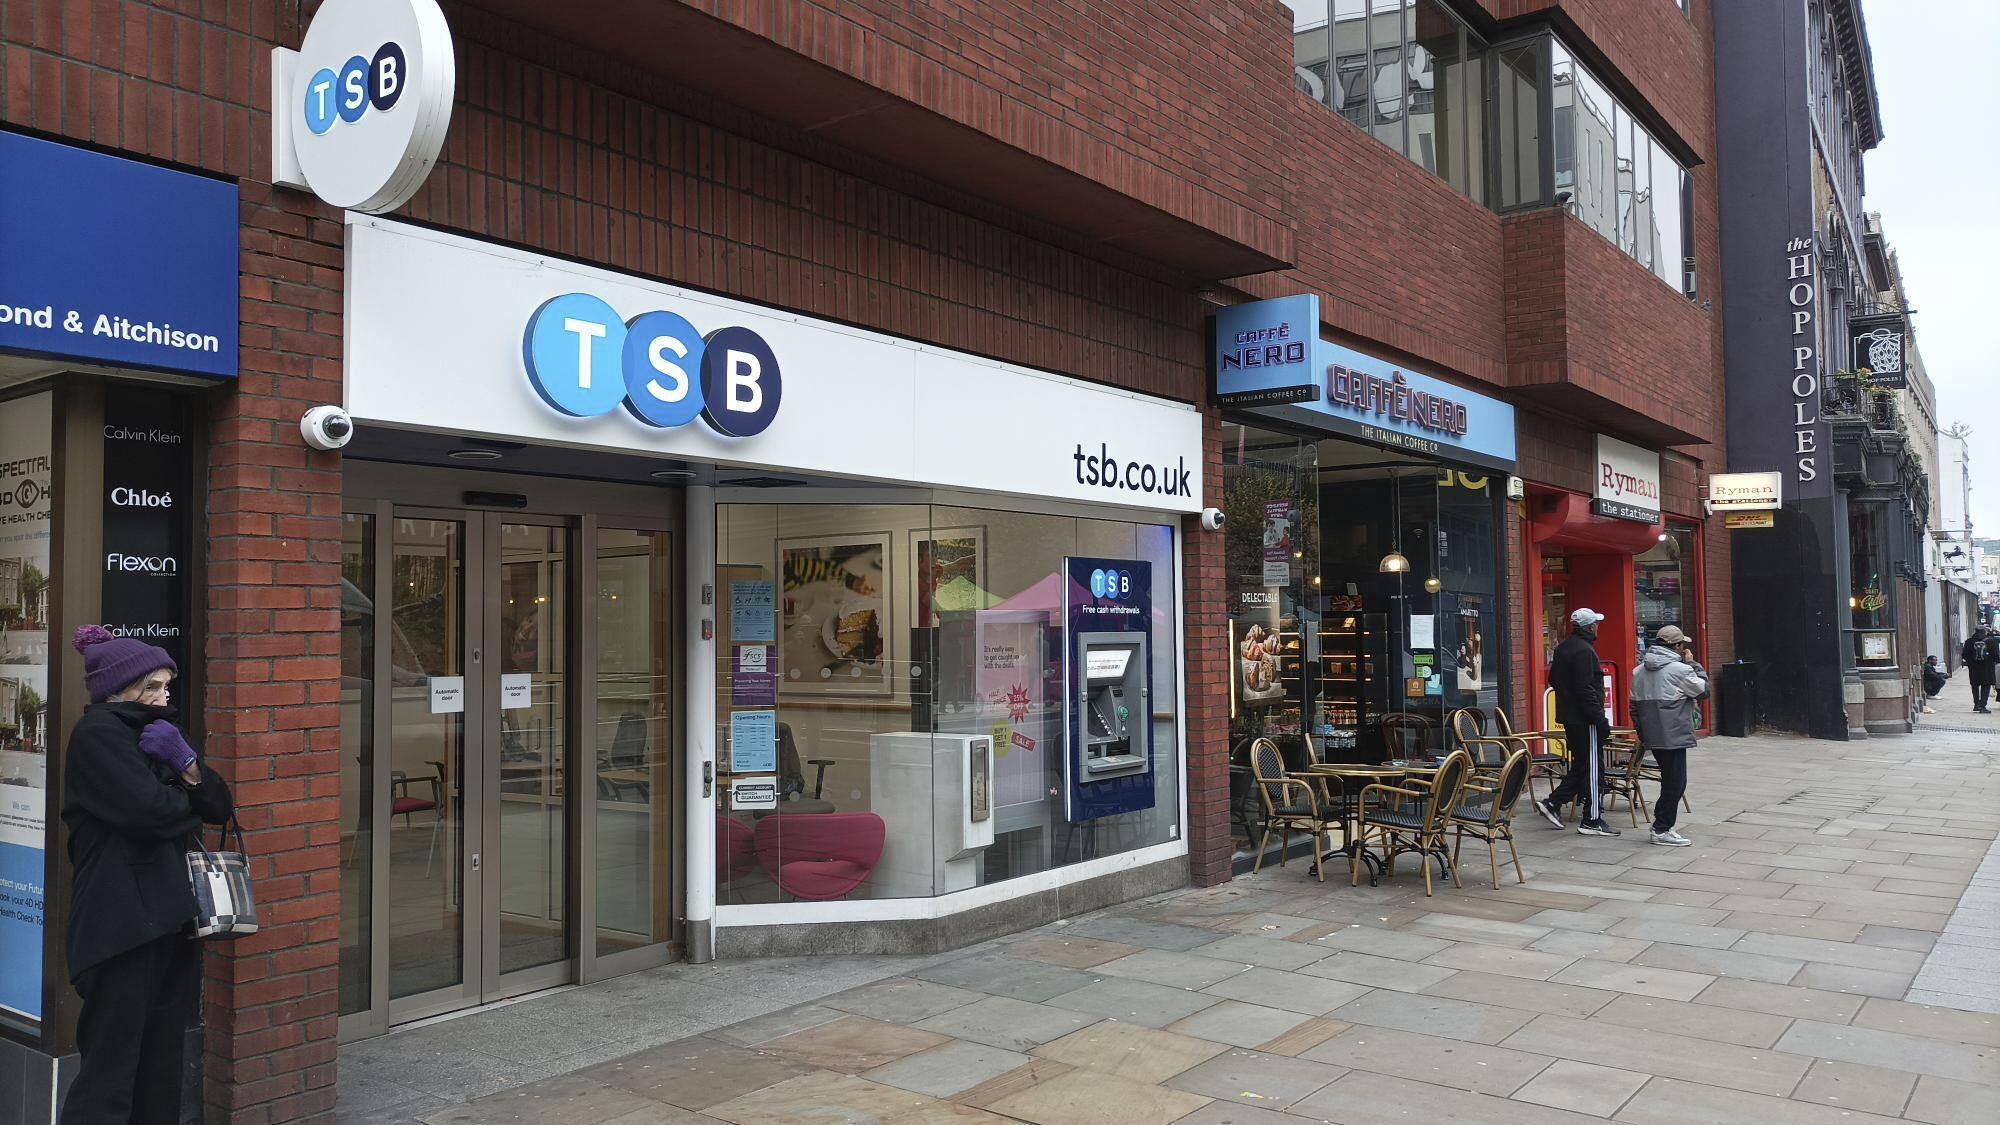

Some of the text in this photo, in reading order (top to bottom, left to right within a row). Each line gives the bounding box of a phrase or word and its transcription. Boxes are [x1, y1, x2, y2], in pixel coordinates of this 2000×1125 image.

[313, 55, 398, 122] TSB
[1787, 237, 1812, 252] the
[0, 304, 219, 353] ond & Aitchison
[564, 316, 764, 415] TSB
[1221, 341, 1305, 372] NERO
[1787, 253, 1817, 481] HOP POLES
[1236, 394, 1265, 402] ITALIAN
[1266, 391, 1294, 399] COFFEE
[1406, 387, 1468, 436] NERO
[103, 424, 181, 444] Calvin Klein
[1361, 425, 1374, 438] THE
[1376, 429, 1402, 445] ITALIAN
[1404, 435, 1428, 451] COFFEE
[1073, 442, 1192, 498] tsb.co.uk
[1601, 462, 1658, 499] Ryman
[111, 486, 173, 508] Chloé
[1715, 486, 1774, 496] Ryman
[8, 512, 35, 523] HEALTH
[1602, 501, 1660, 523] the stationer
[107, 553, 177, 572] Flexon
[1094, 575, 1130, 593] TSB
[1242, 592, 1279, 603] DELECTABLE
[1860, 592, 1887, 611] Cider
[1082, 604, 1140, 614] Free cash withdrawals
[148, 624, 180, 637] Klein
[1013, 703, 1024, 711] OFF
[1015, 735, 1030, 748] SALE
[17, 911, 35, 922] Check
